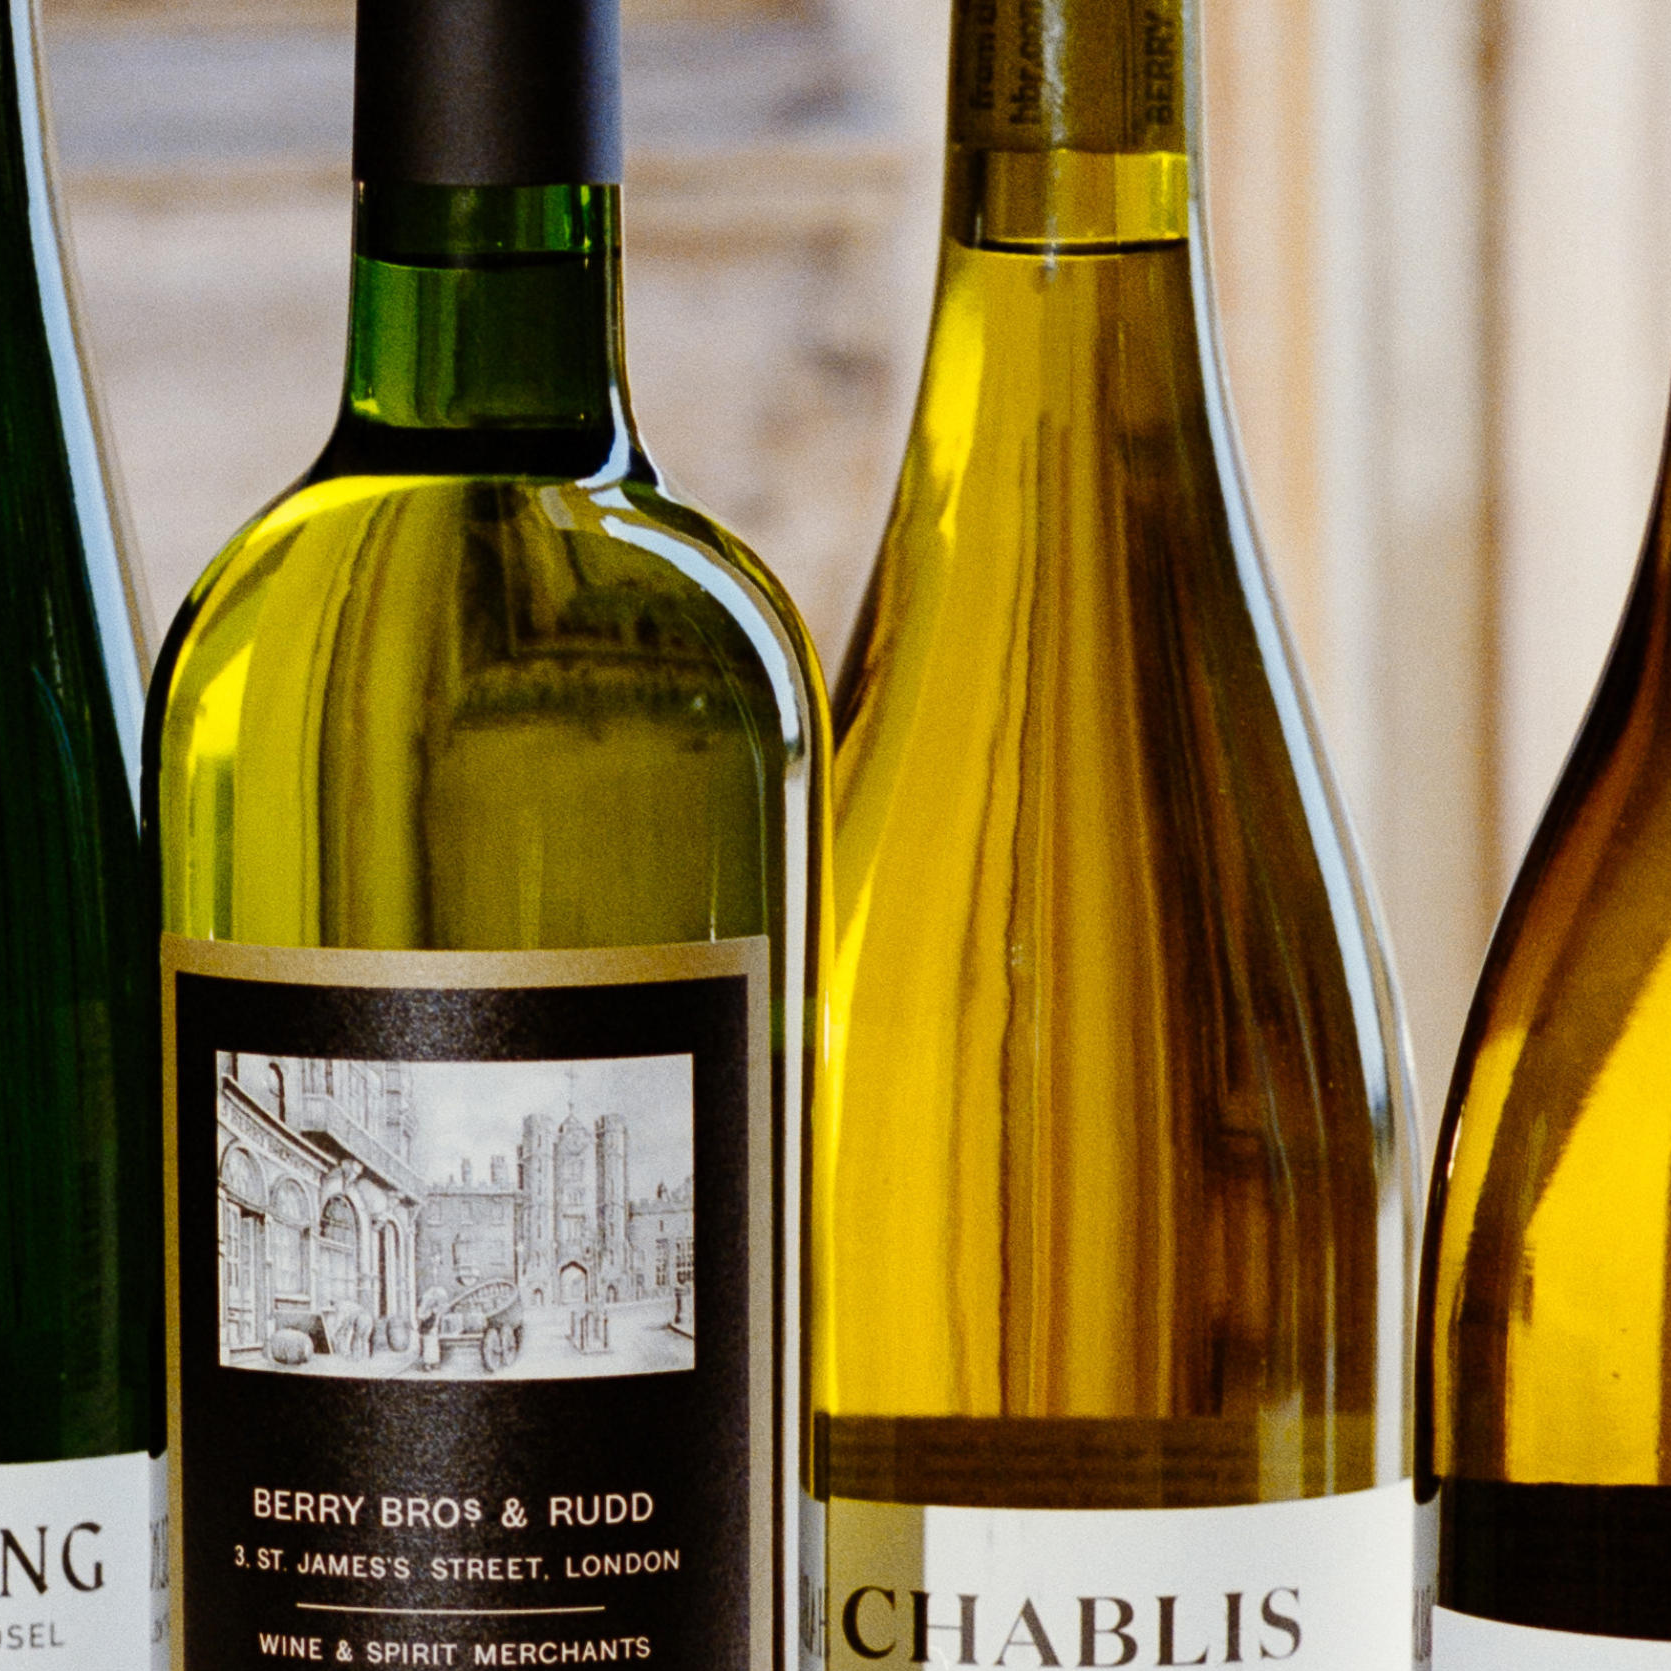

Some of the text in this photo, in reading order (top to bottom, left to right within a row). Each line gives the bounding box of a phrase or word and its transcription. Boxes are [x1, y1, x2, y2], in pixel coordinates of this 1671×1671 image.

[253, 1486, 365, 1526] BERRY
[500, 1496, 529, 1530] &
[549, 1491, 655, 1528] RUDD
[296, 1551, 411, 1581] JAMES'S
[565, 1548, 681, 1579] LONDON
[841, 1585, 1302, 1669] CHABLIS
[258, 1632, 652, 1667] WINE & SPIRIT MERCHANTS
